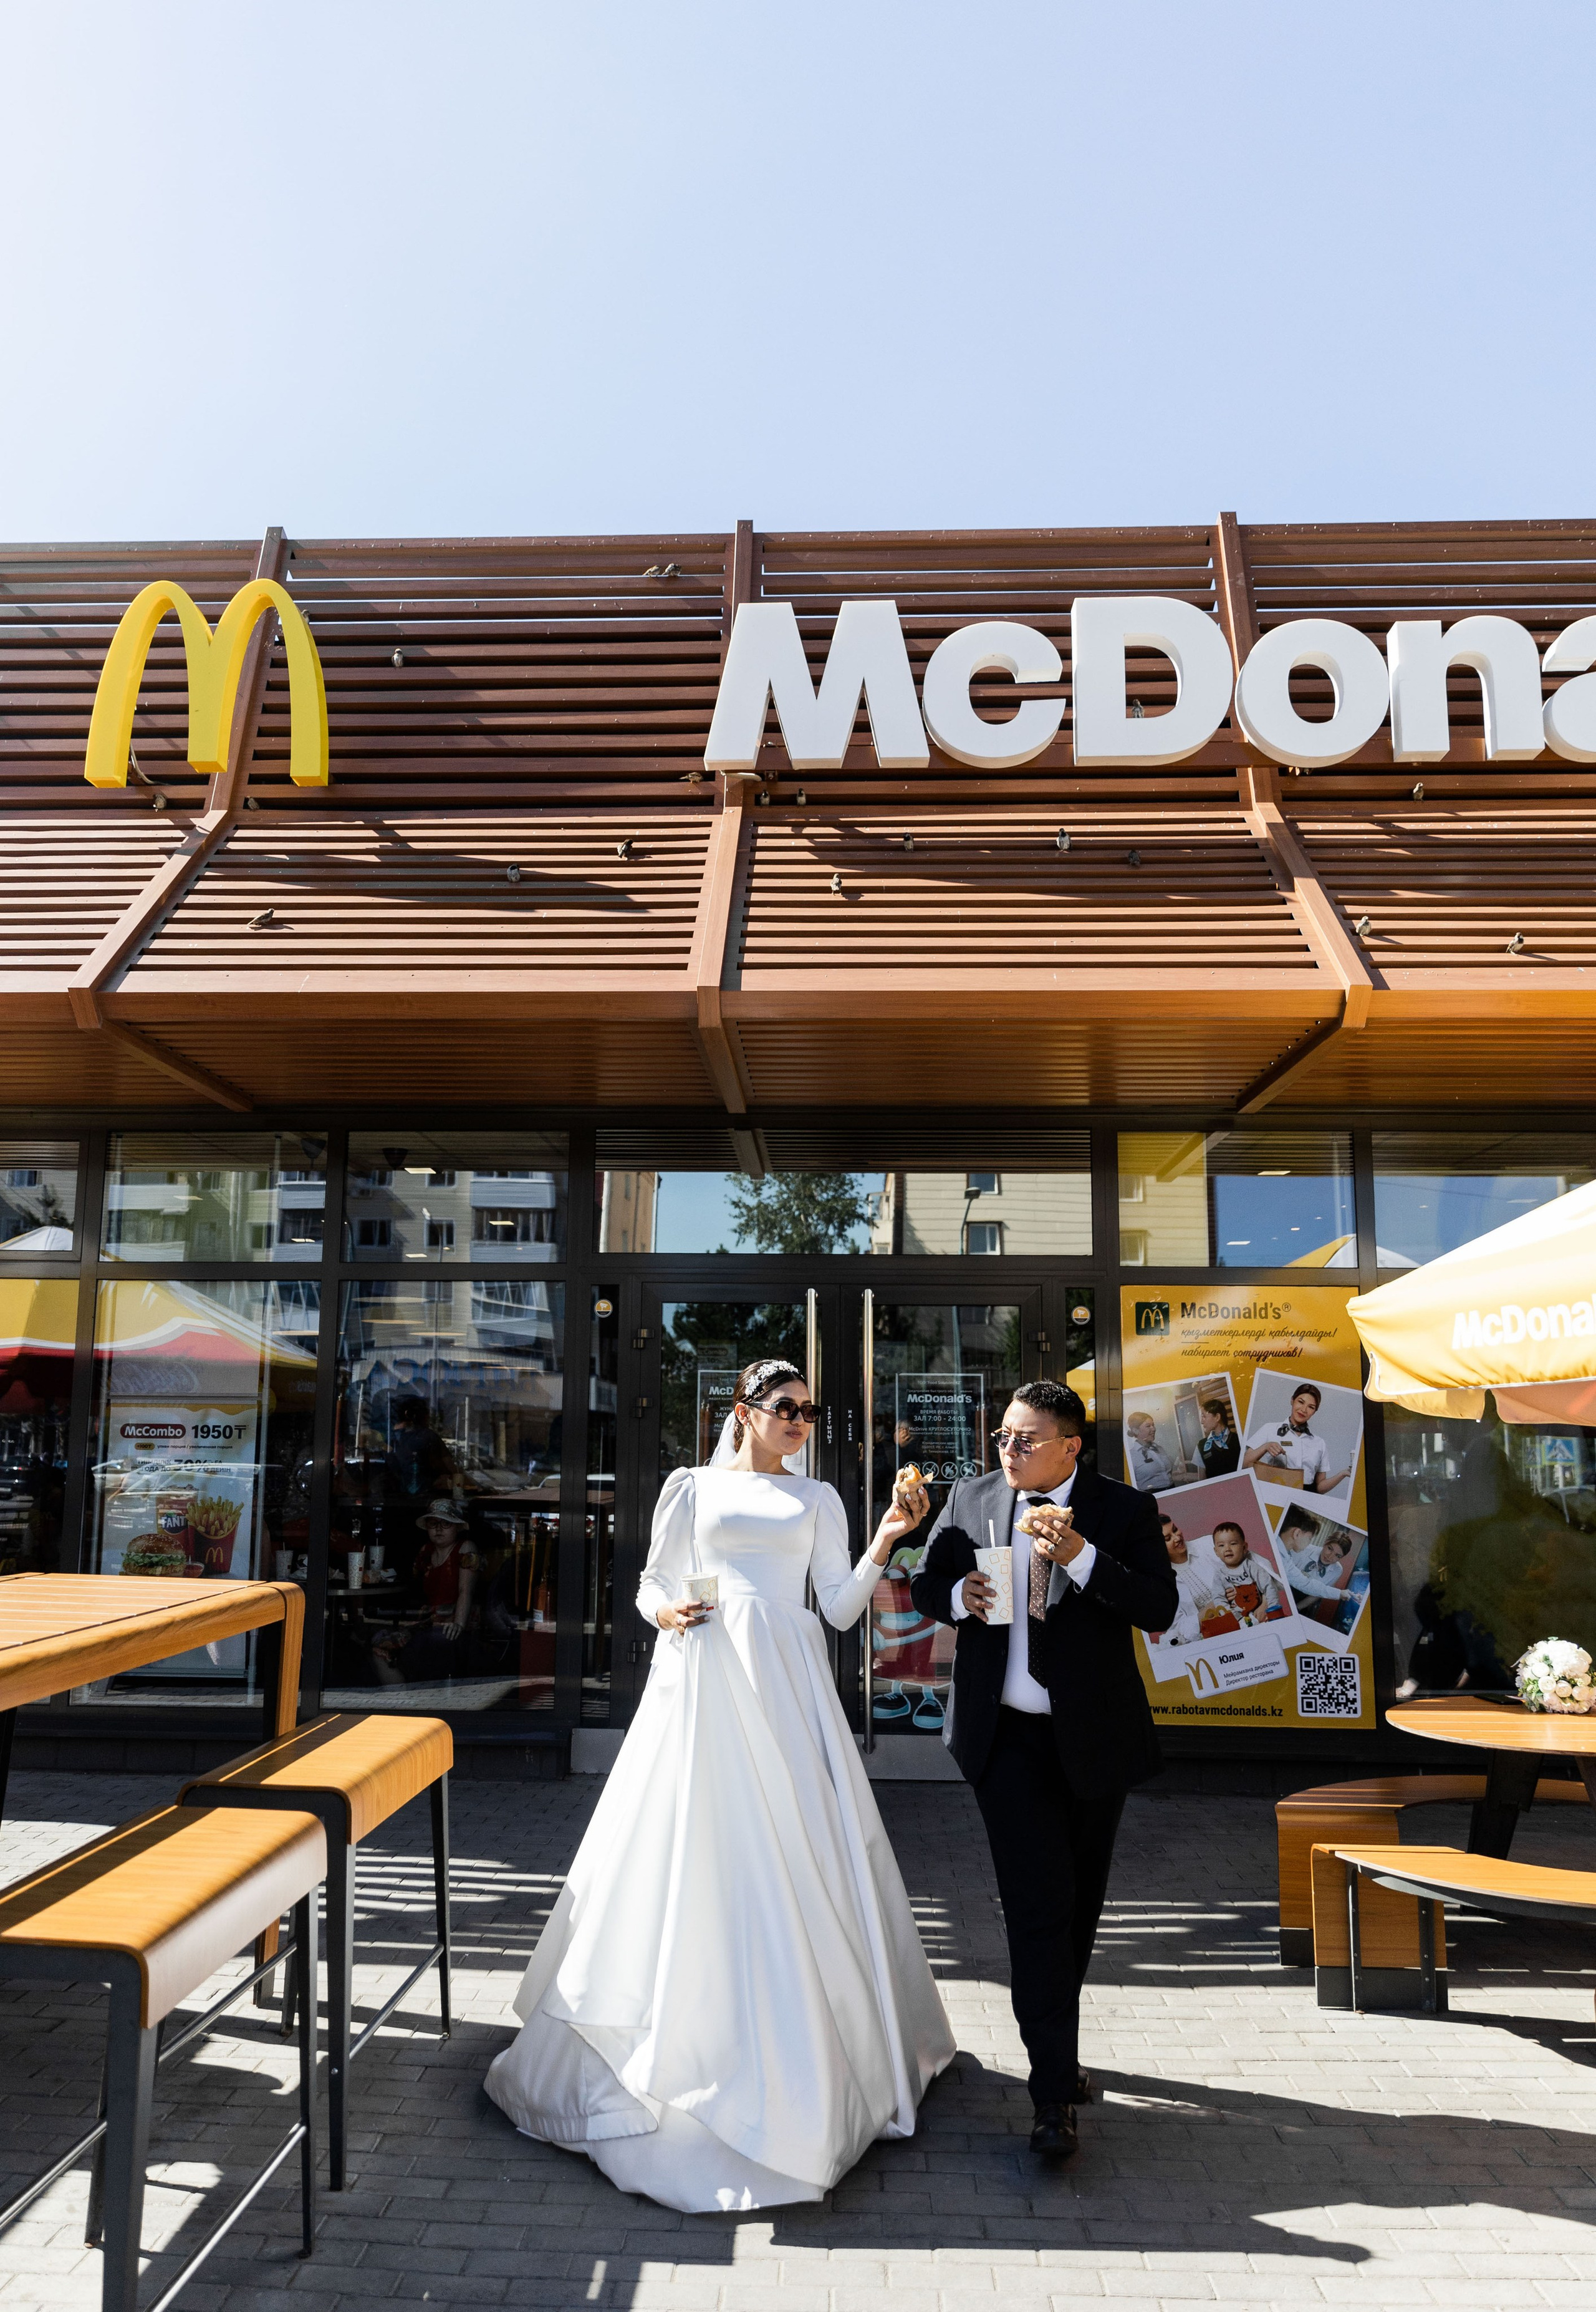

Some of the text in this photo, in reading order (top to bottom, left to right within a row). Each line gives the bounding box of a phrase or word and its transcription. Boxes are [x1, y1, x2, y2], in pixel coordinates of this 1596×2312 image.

[1181, 1347, 1304, 1362] набирает сотрудников!
[907, 1394, 972, 1403] McDonald's
[124, 1426, 183, 1437] McCombo
[161, 1515, 186, 1528] FANT
[1219, 1652, 1244, 1664] Юлия
[1223, 1660, 1280, 1679] Мейрамхана директоры
[1226, 1669, 1274, 1686] Директор ресторана
[1150, 1704, 1283, 1717] ww.rabotavmcdonalds.kz
